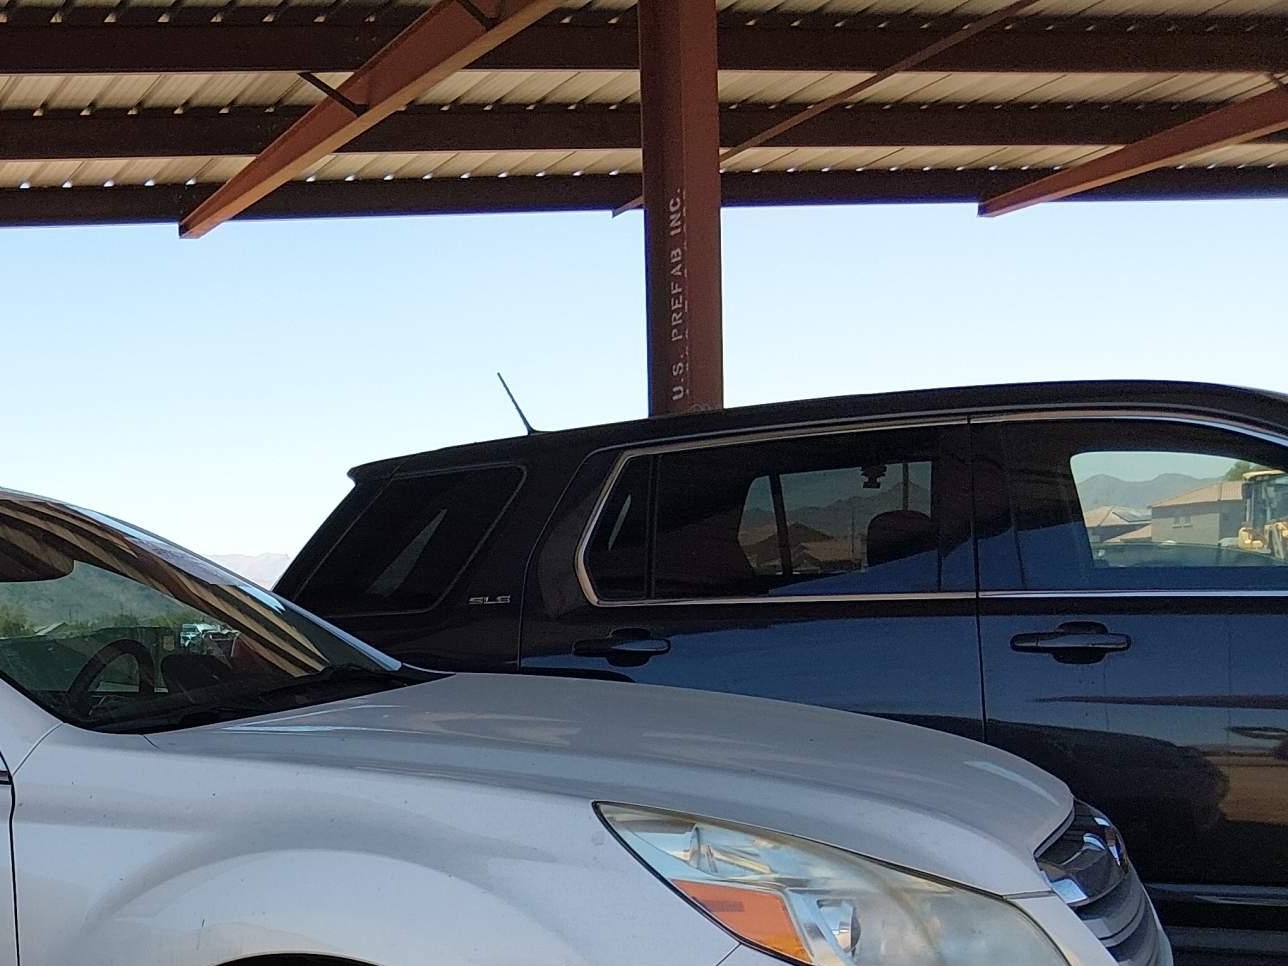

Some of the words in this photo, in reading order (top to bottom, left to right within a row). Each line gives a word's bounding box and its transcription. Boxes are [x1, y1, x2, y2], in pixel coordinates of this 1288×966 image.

[669, 187, 681, 237] INC.
[670, 247, 683, 342] PREFAB
[671, 353, 685, 401] U.S.
